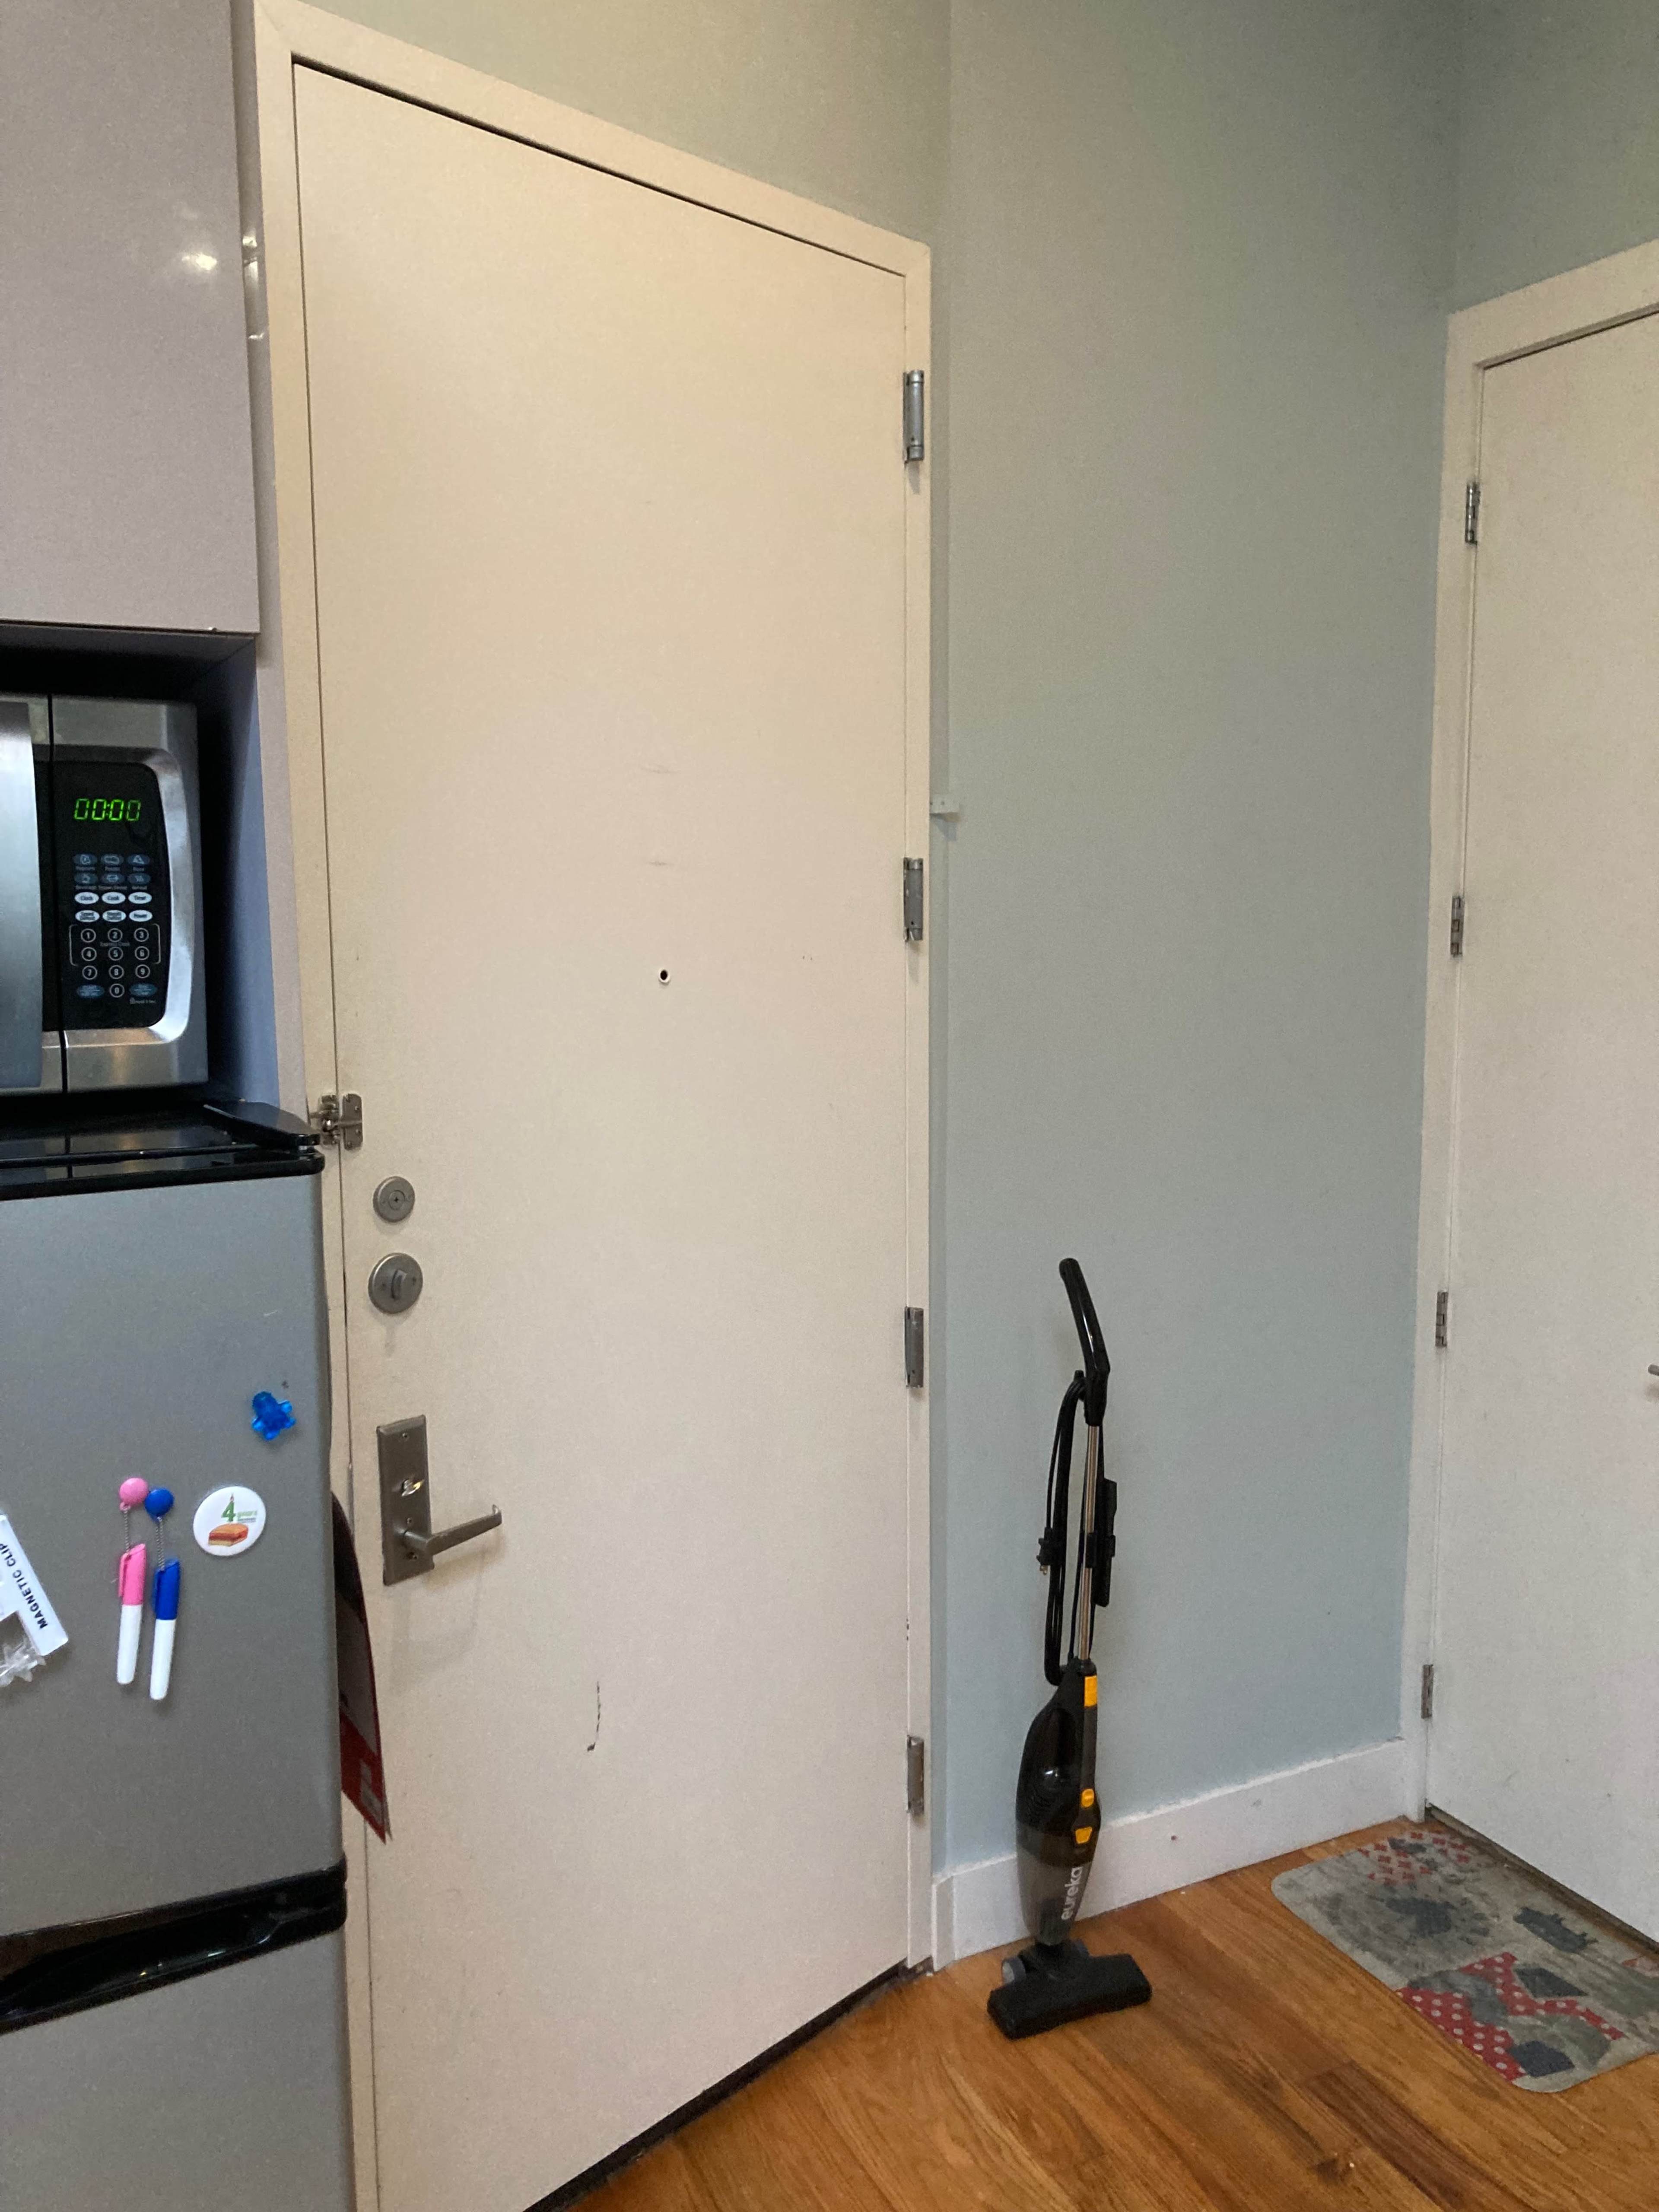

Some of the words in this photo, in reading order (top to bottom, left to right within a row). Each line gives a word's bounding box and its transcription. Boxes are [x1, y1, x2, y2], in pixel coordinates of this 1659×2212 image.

[74, 798, 141, 821] 00:00
[221, 1501, 236, 1522] 4
[13, 1570, 48, 1629] MAGNETIC
[1061, 1866, 1083, 1920] eureka
